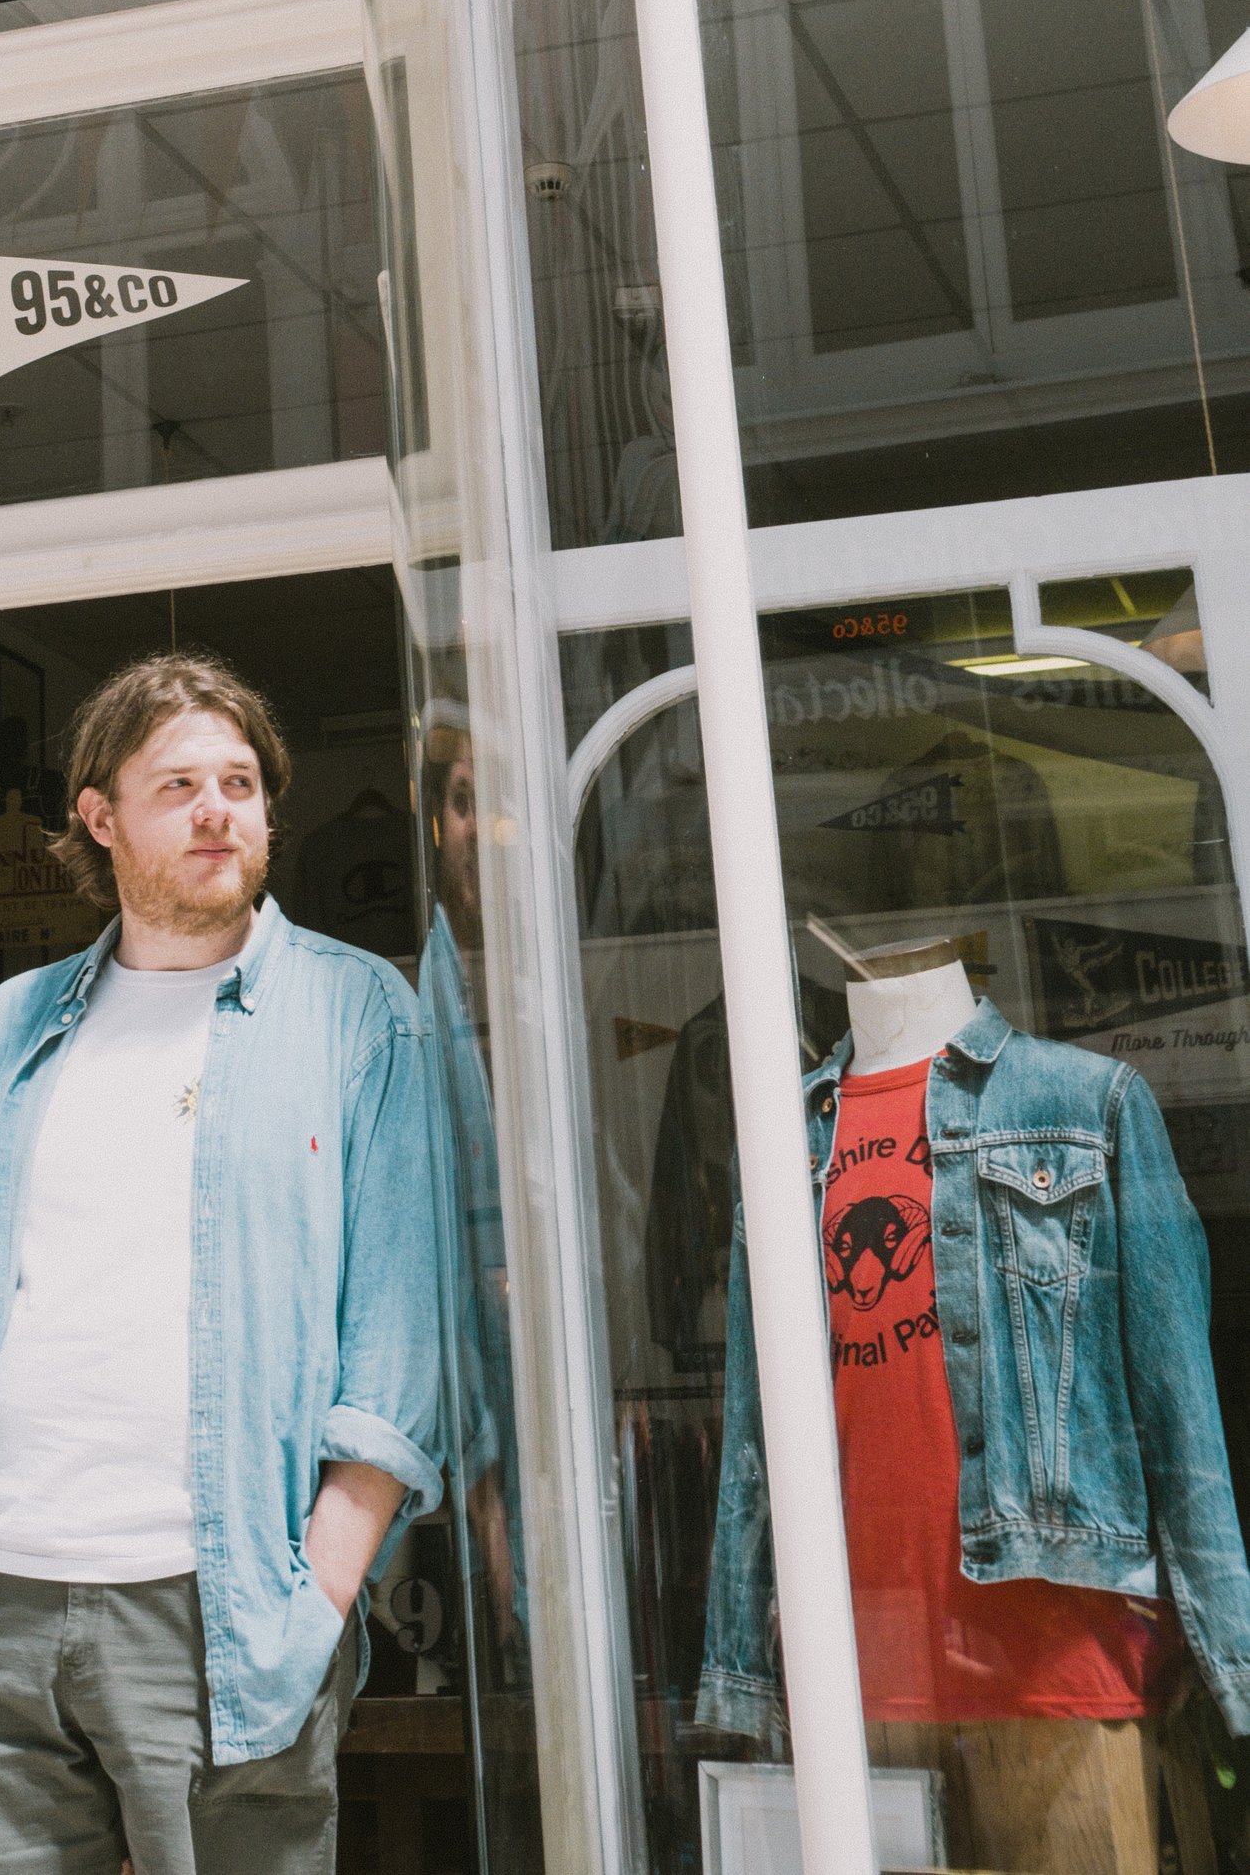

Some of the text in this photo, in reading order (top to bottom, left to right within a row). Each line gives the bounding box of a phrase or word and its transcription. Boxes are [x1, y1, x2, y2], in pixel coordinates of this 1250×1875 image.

[10, 270, 178, 336] 95&CO
[1135, 950, 1245, 1004] COLLEGE
[1110, 1031, 1166, 1053] More
